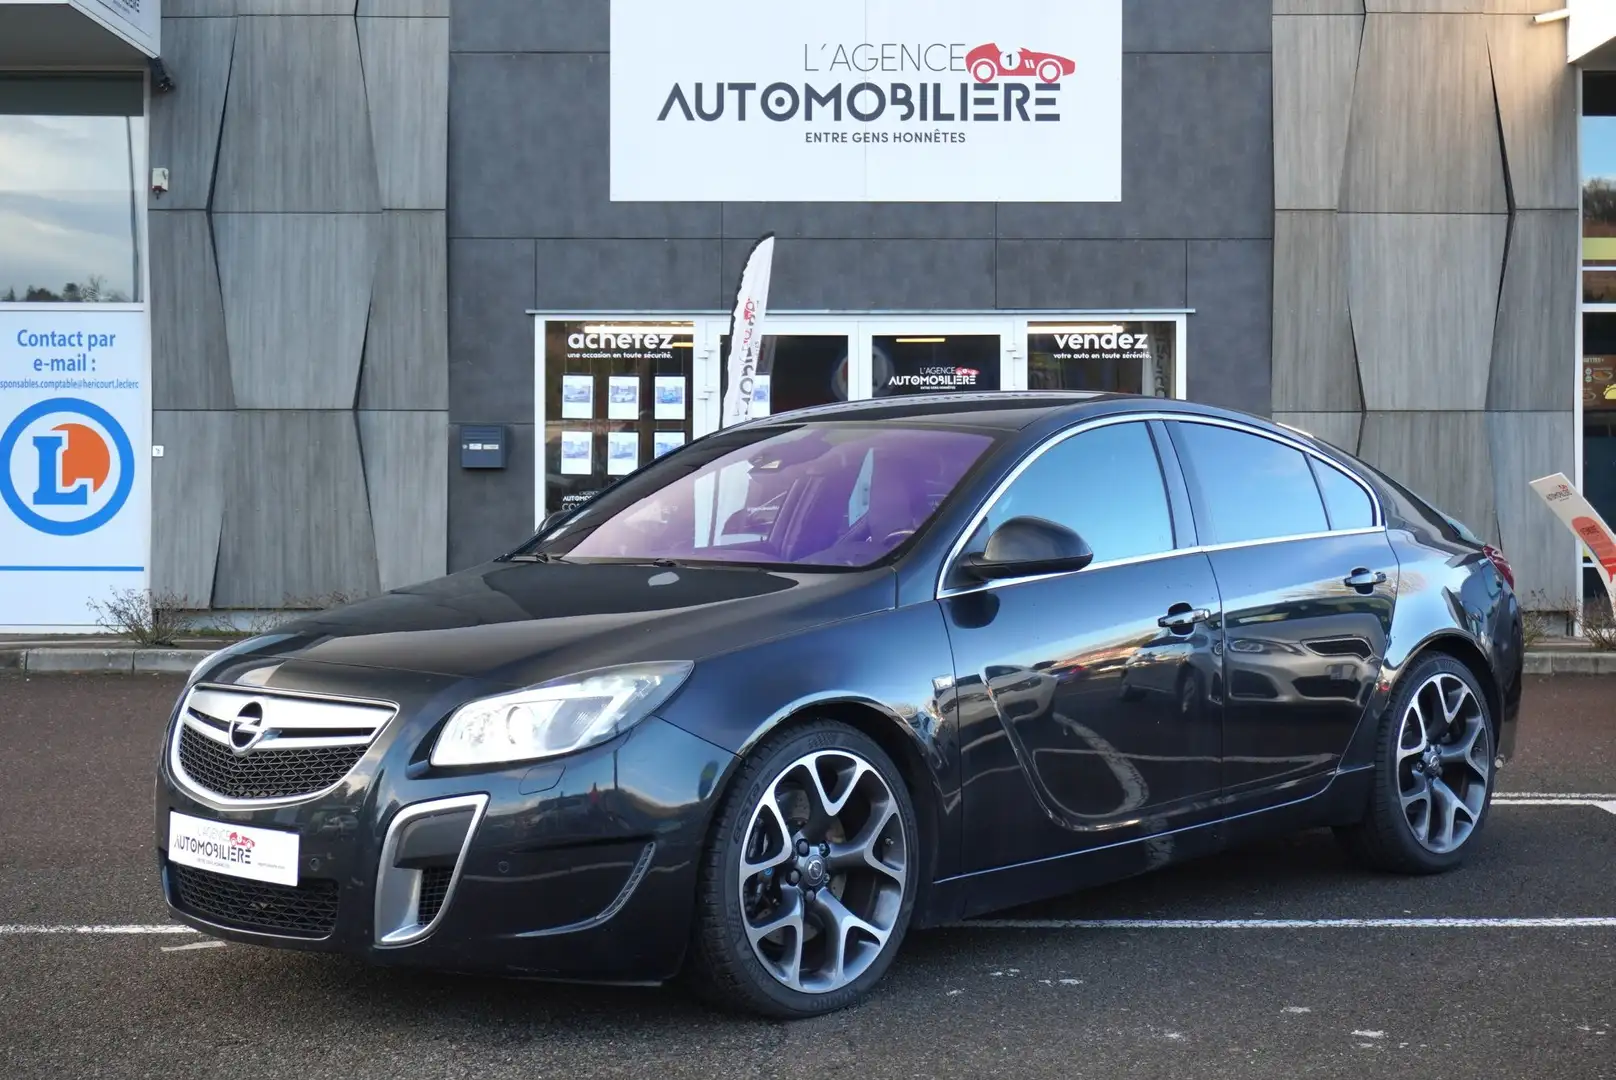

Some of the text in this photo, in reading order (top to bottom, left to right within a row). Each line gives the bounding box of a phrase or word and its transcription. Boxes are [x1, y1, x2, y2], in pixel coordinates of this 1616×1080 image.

[805, 128, 966, 143] ENTRE GENS HONNÊTES
[17, 329, 116, 351] Contact par
[1053, 324, 1149, 349] vendez
[33, 353, 87, 372] e-mail
[582, 350, 611, 358] occasion
